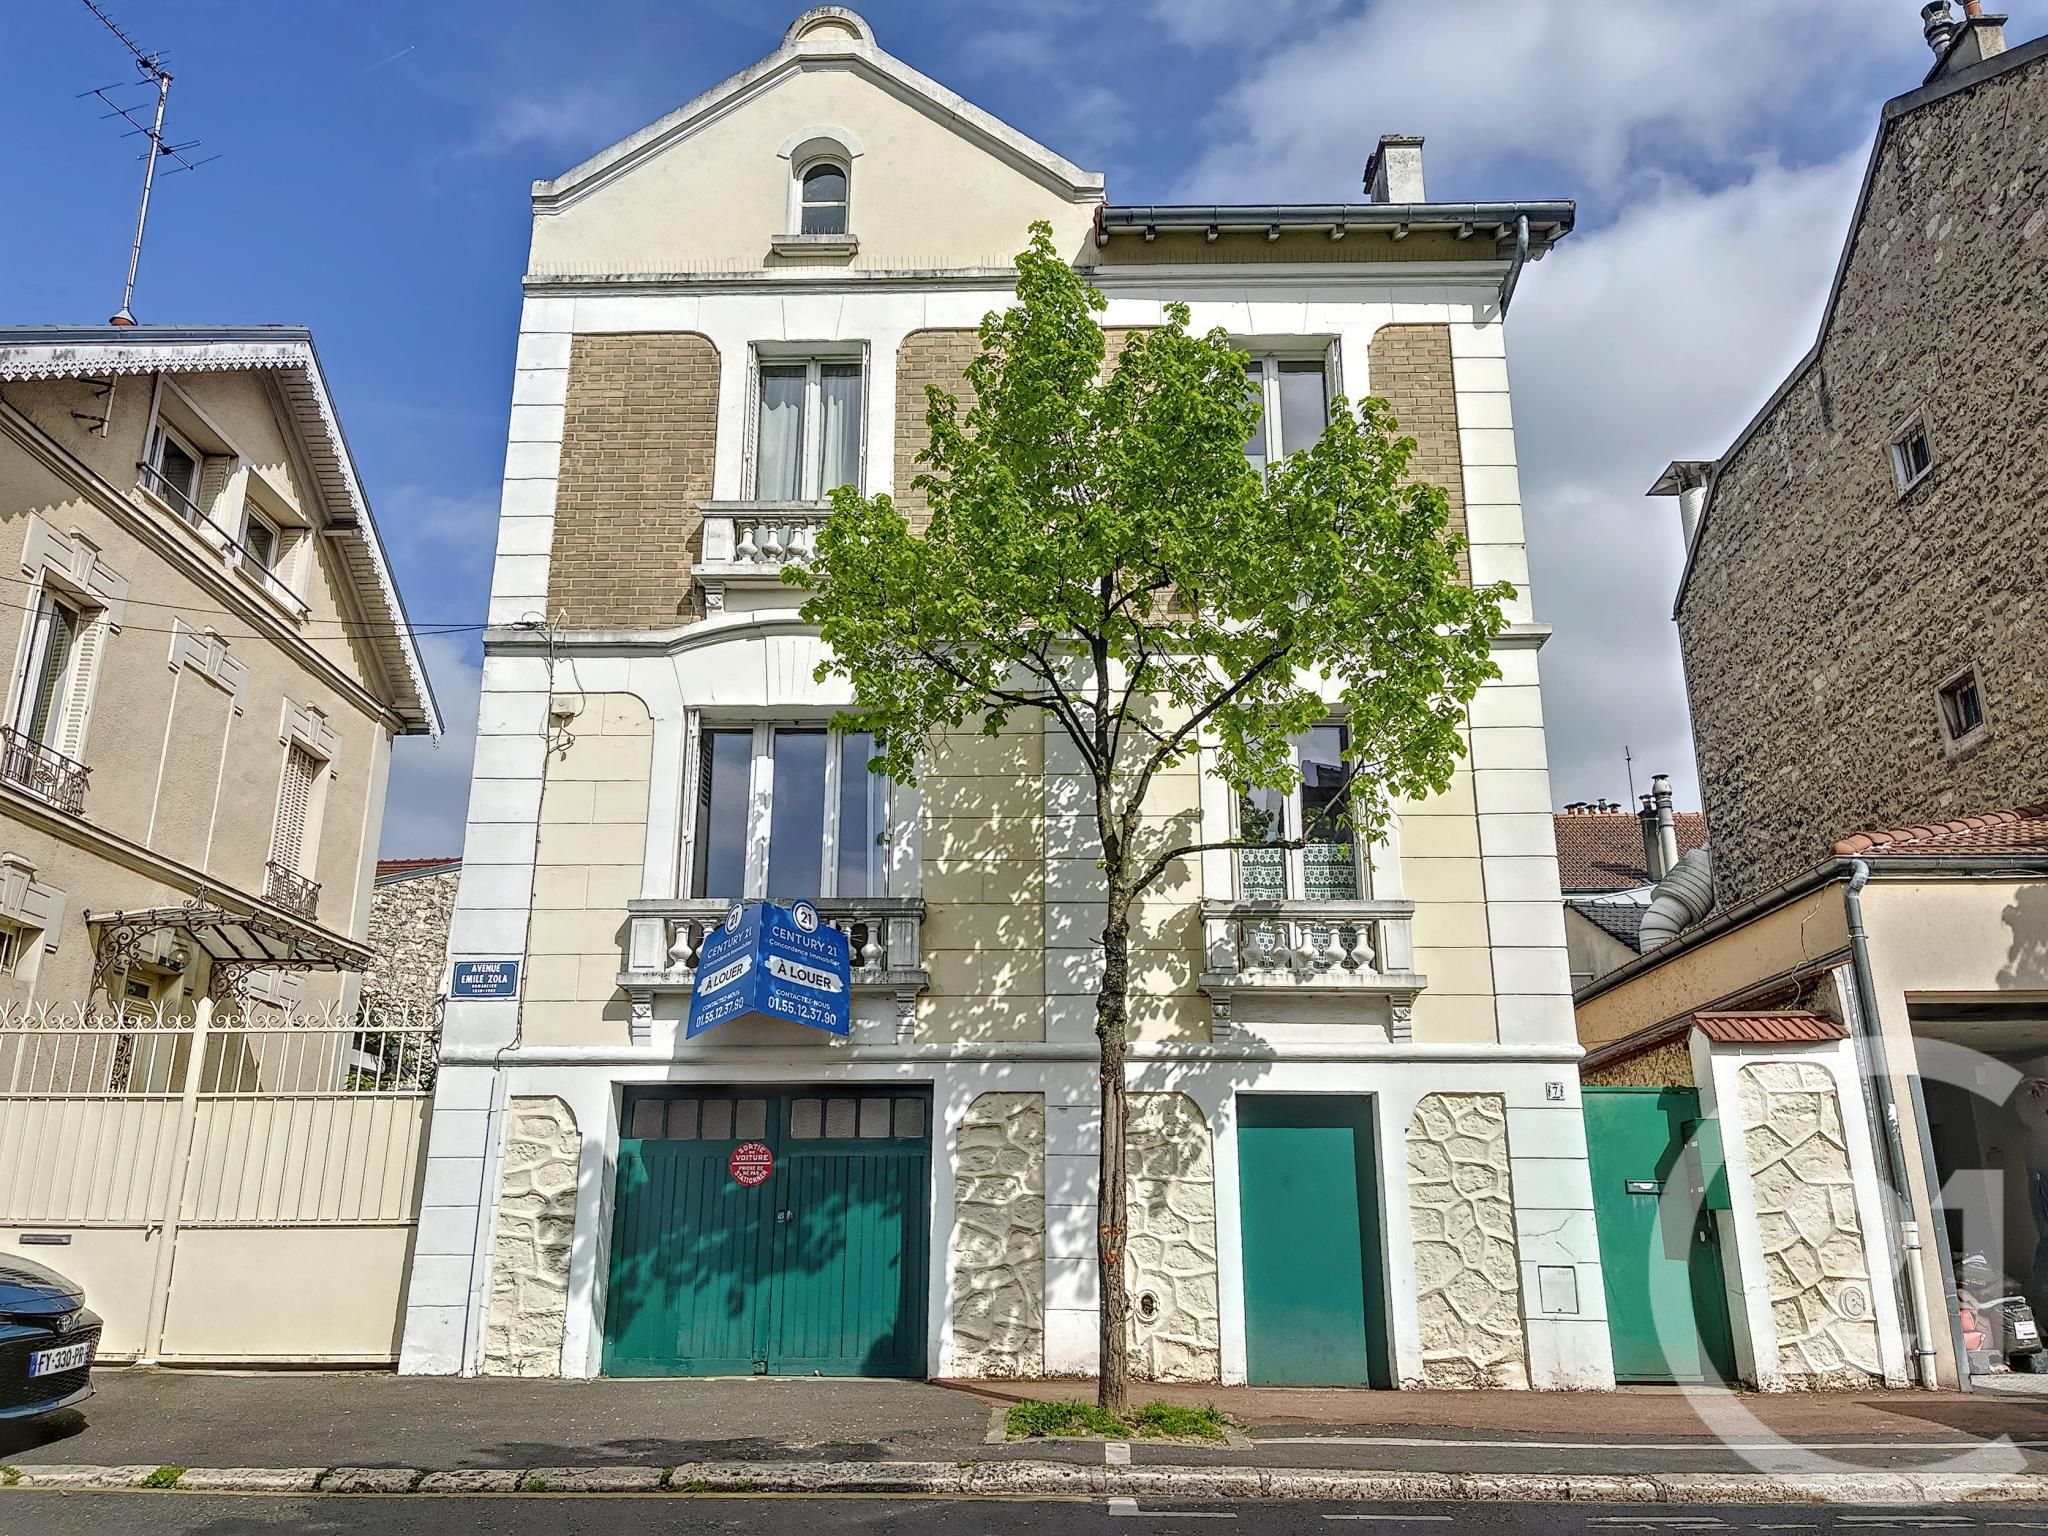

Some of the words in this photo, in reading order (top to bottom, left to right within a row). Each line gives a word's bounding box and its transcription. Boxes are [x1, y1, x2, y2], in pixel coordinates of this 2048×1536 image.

[729, 912, 739, 928] 21
[801, 911, 812, 926] 21
[707, 931, 744, 959] CENTURY
[744, 926, 752, 940] 21
[769, 938, 809, 957] Concordance
[772, 926, 825, 952] CENTURY
[827, 945, 838, 957] 21
[471, 964, 501, 973] AVENUE
[777, 959, 787, 976] À
[790, 966, 832, 990] LOUER
[461, 975, 484, 983] EMILE
[488, 975, 508, 983] ZOLA
[705, 976, 713, 992] À
[713, 963, 744, 988] LOUER
[775, 988, 831, 1010] CONTACTEZ-NOUS
[768, 995, 837, 1026] 01.55.12.37.90
[1552, 1086, 1558, 1096] 7
[738, 1143, 766, 1154] SORTIE
[734, 1170, 769, 1184] STATIONNER
